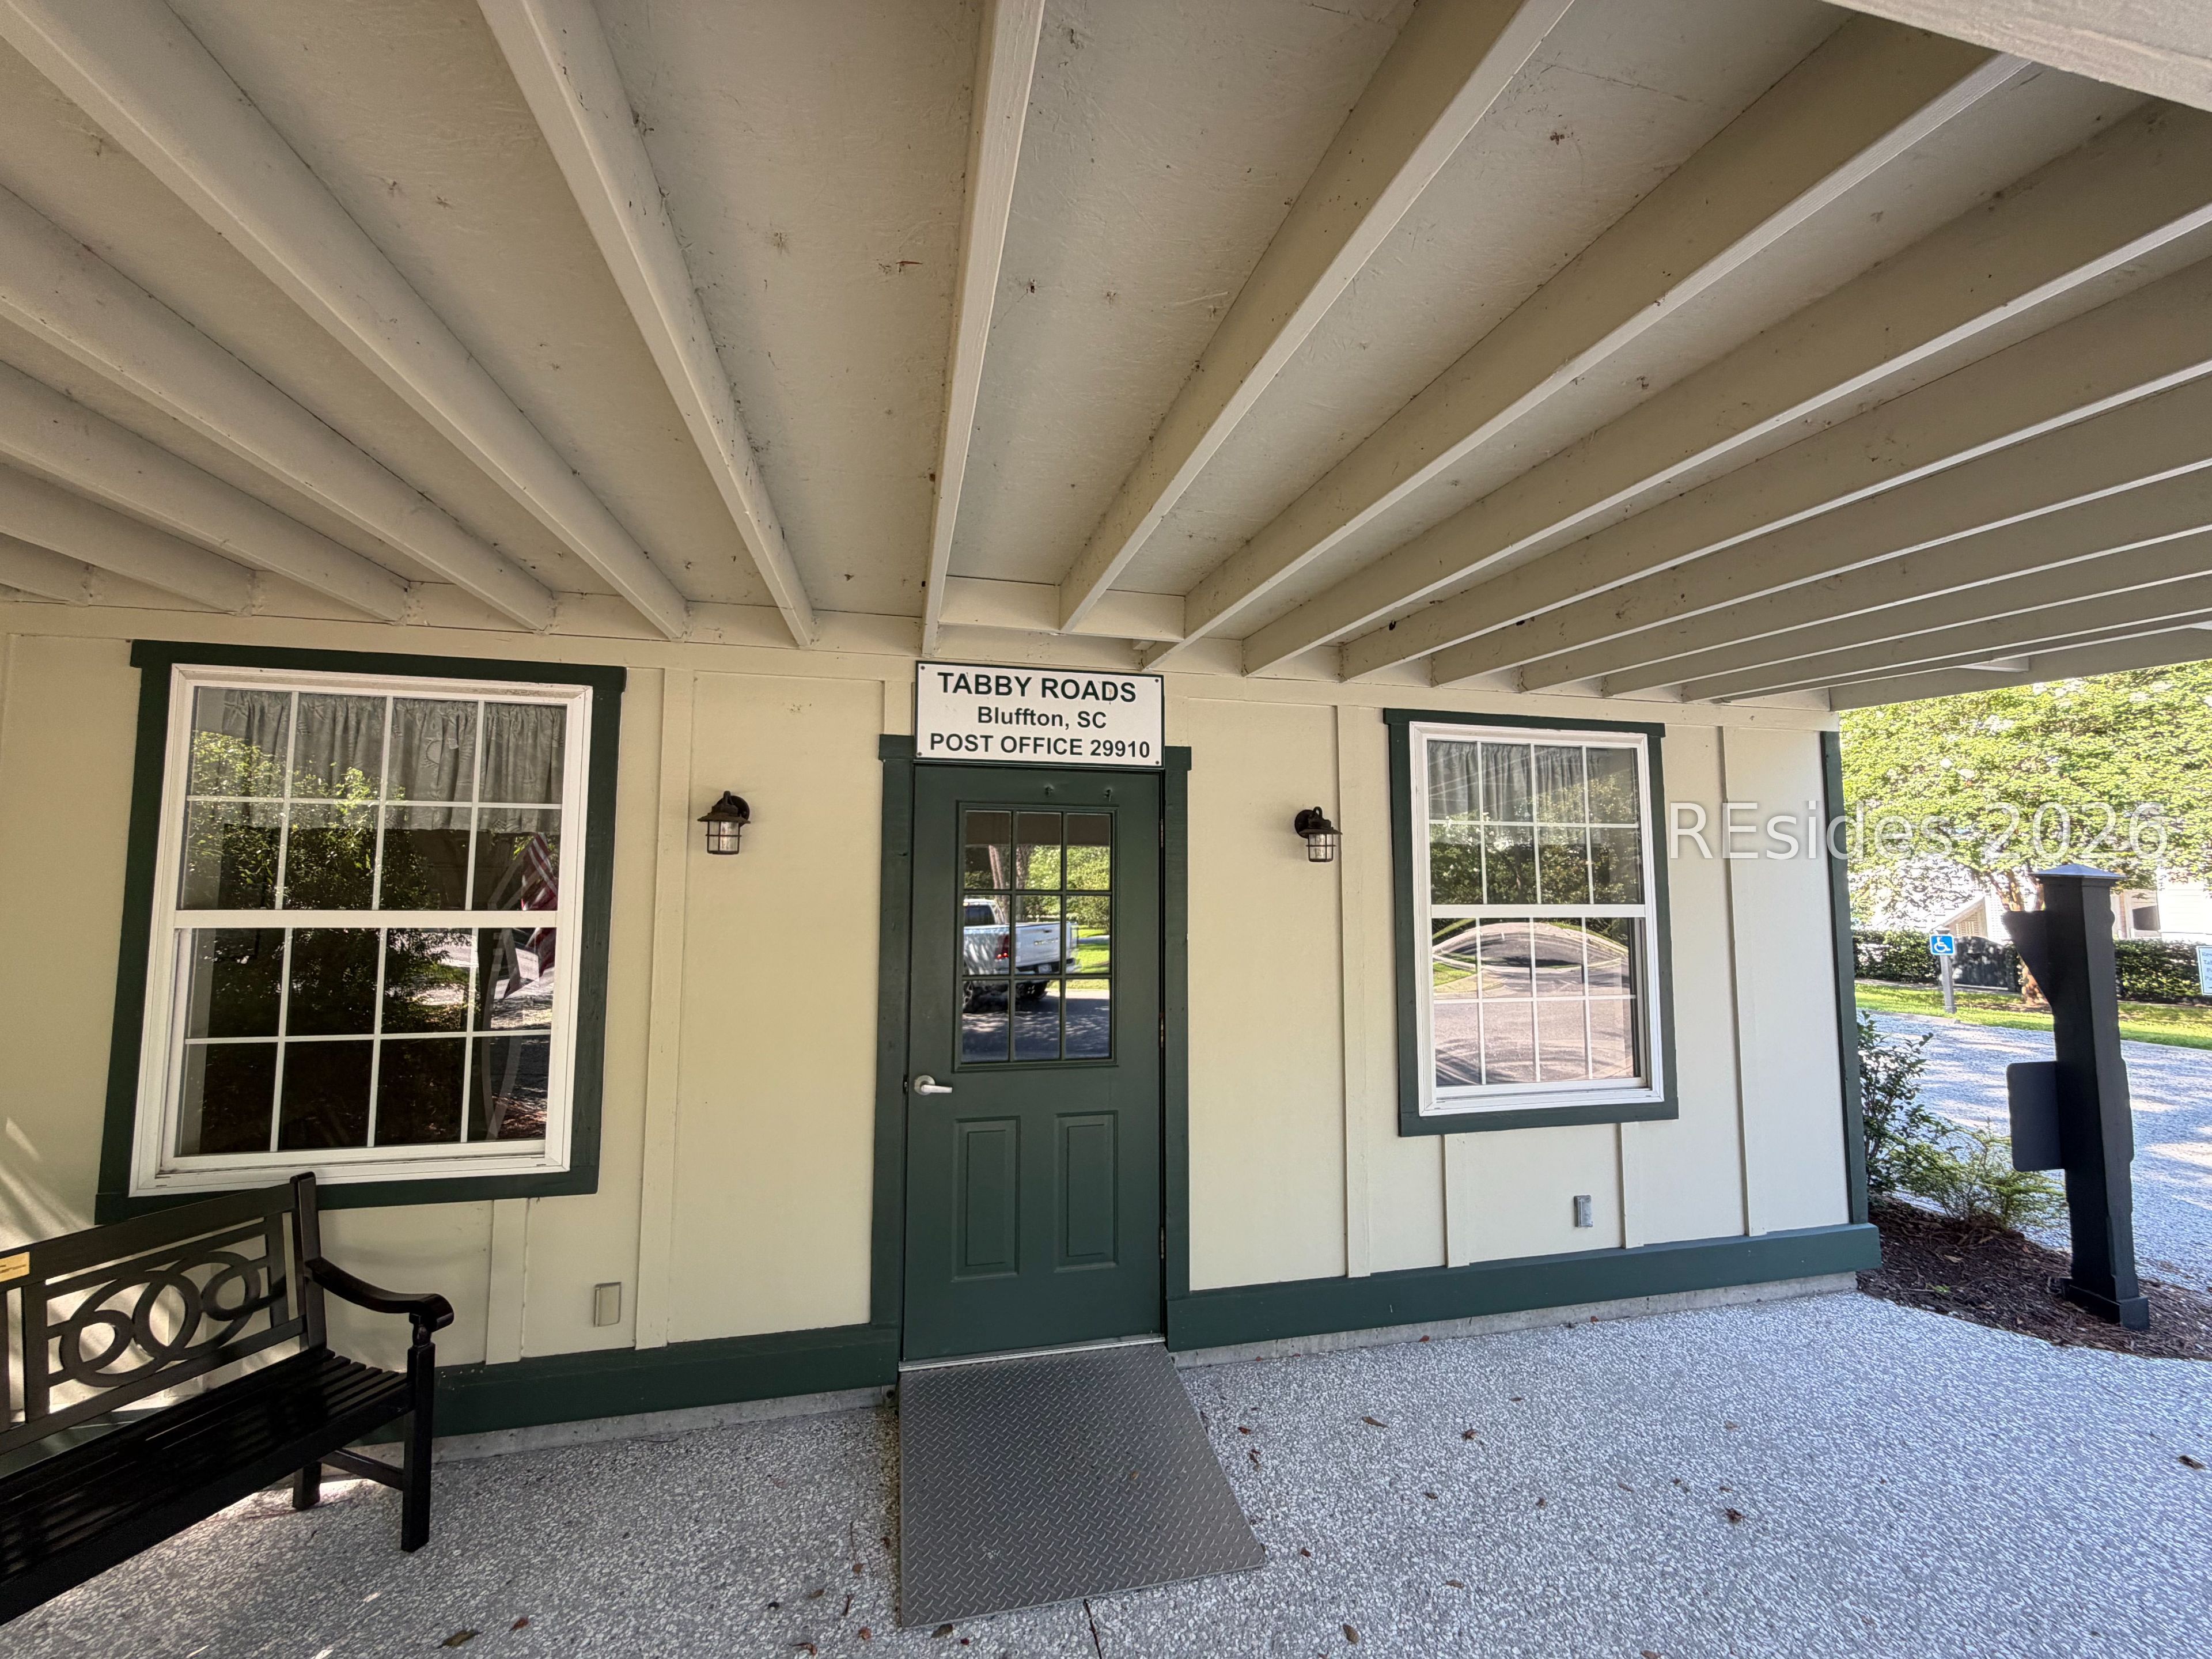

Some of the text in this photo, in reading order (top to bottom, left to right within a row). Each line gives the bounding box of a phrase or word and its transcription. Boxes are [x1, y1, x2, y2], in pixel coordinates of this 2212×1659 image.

[937, 672, 1136, 703] TABBY ROADS
[978, 706, 1107, 730] Bluffton, SC
[930, 733, 1150, 758] POST OFFICE 29910
